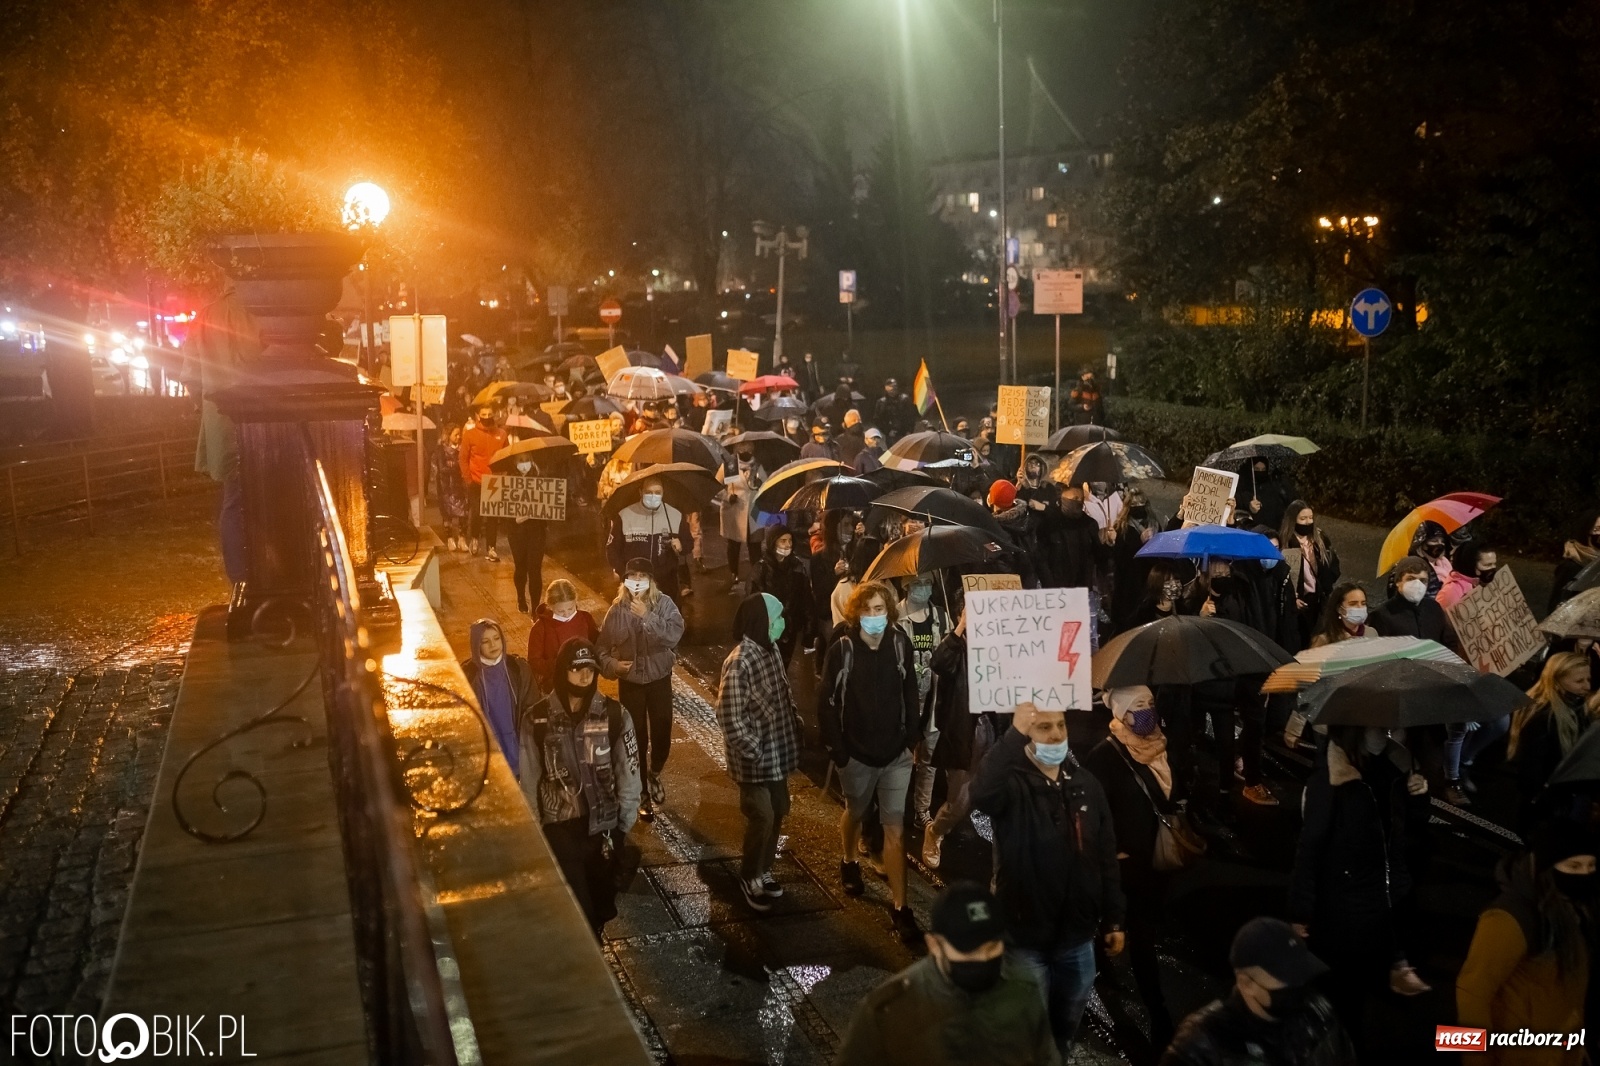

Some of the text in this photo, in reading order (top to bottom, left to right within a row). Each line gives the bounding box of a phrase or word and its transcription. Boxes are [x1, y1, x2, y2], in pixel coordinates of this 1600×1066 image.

[573, 430, 608, 441] DOBREM
[481, 500, 565, 520] WYPIERDALAJTE
[971, 589, 1068, 615] UKRADŁEŚ
[974, 614, 1053, 638] KSIĘŻYC
[971, 640, 1046, 662] TO TAM
[978, 683, 1080, 711] UCIEKAJ
